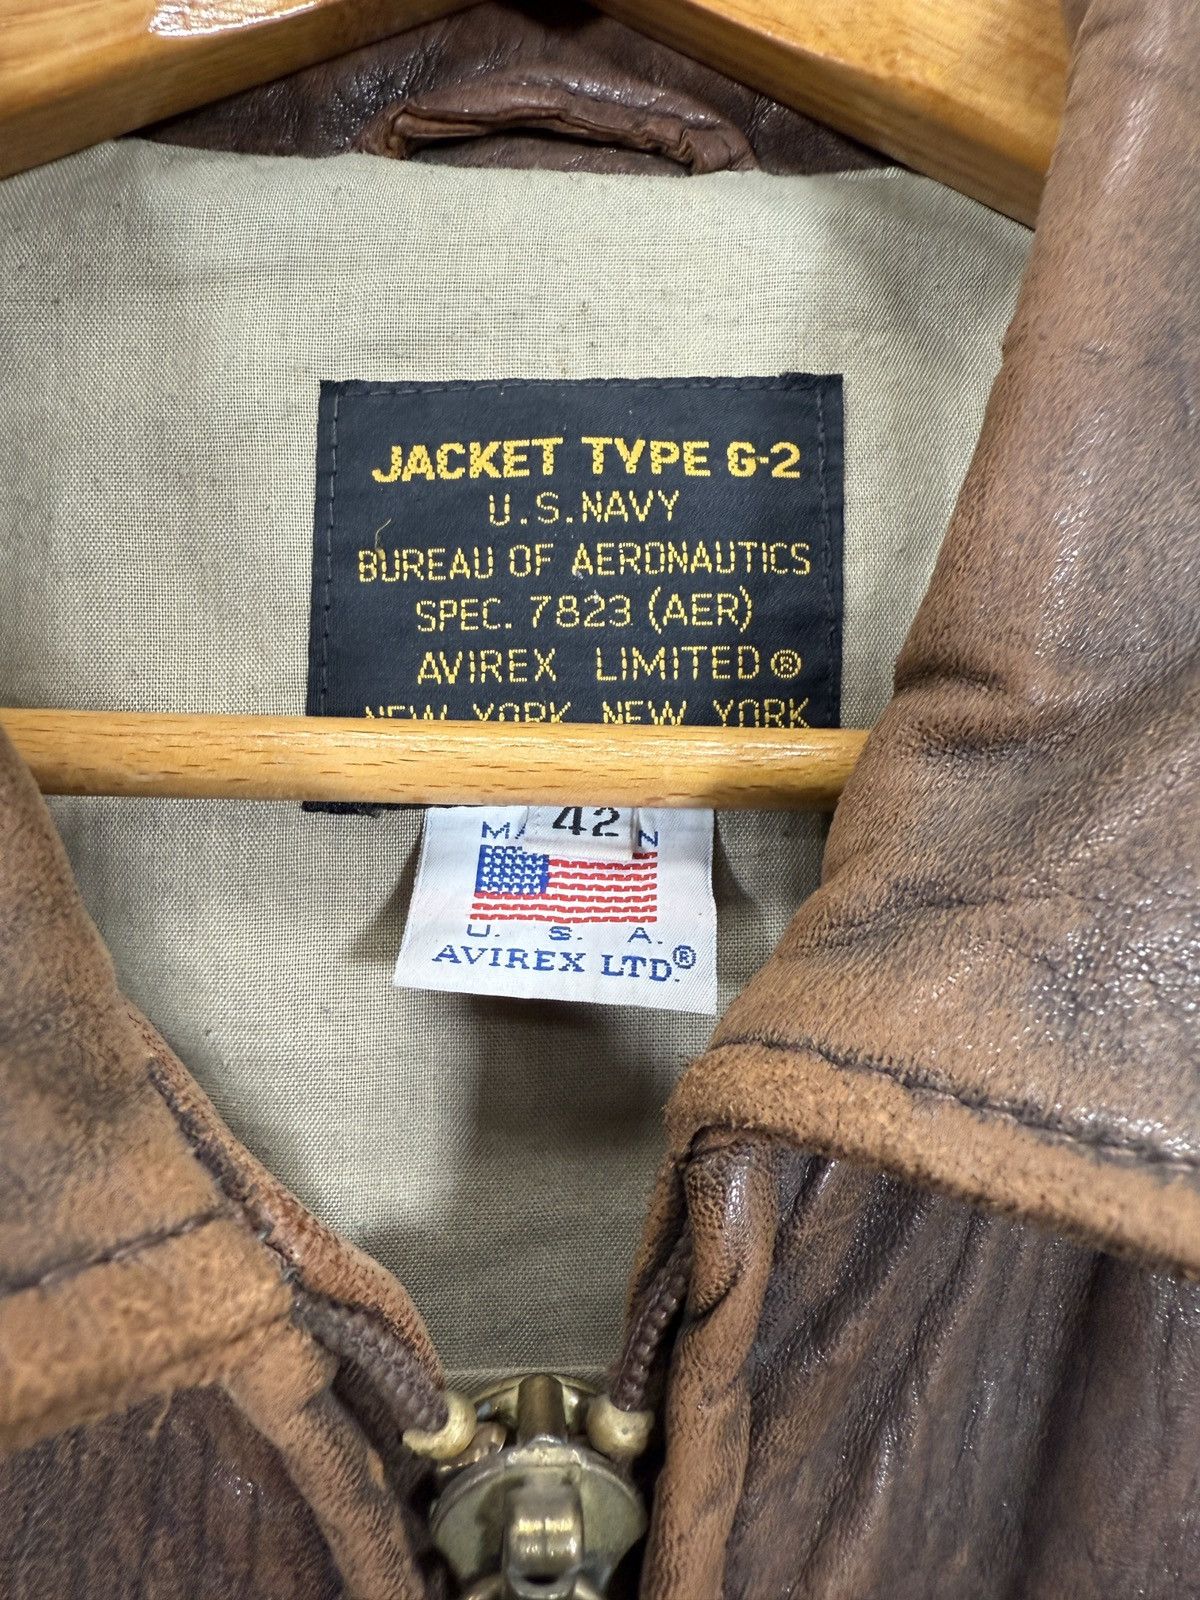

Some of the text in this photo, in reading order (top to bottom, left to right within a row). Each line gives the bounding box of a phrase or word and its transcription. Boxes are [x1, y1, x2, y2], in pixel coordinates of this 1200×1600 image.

[371, 437, 801, 483] JACKET TYPE G-2
[357, 541, 811, 583] BUREAU OF AERONAUTICS
[415, 586, 753, 634] SPEC. 7823 (AER)
[416, 647, 558, 685] AVIREX
[602, 700, 687, 726] NEW
[712, 697, 811, 729] YORK
[551, 806, 621, 837] 42
[431, 944, 587, 973] AVIREX
